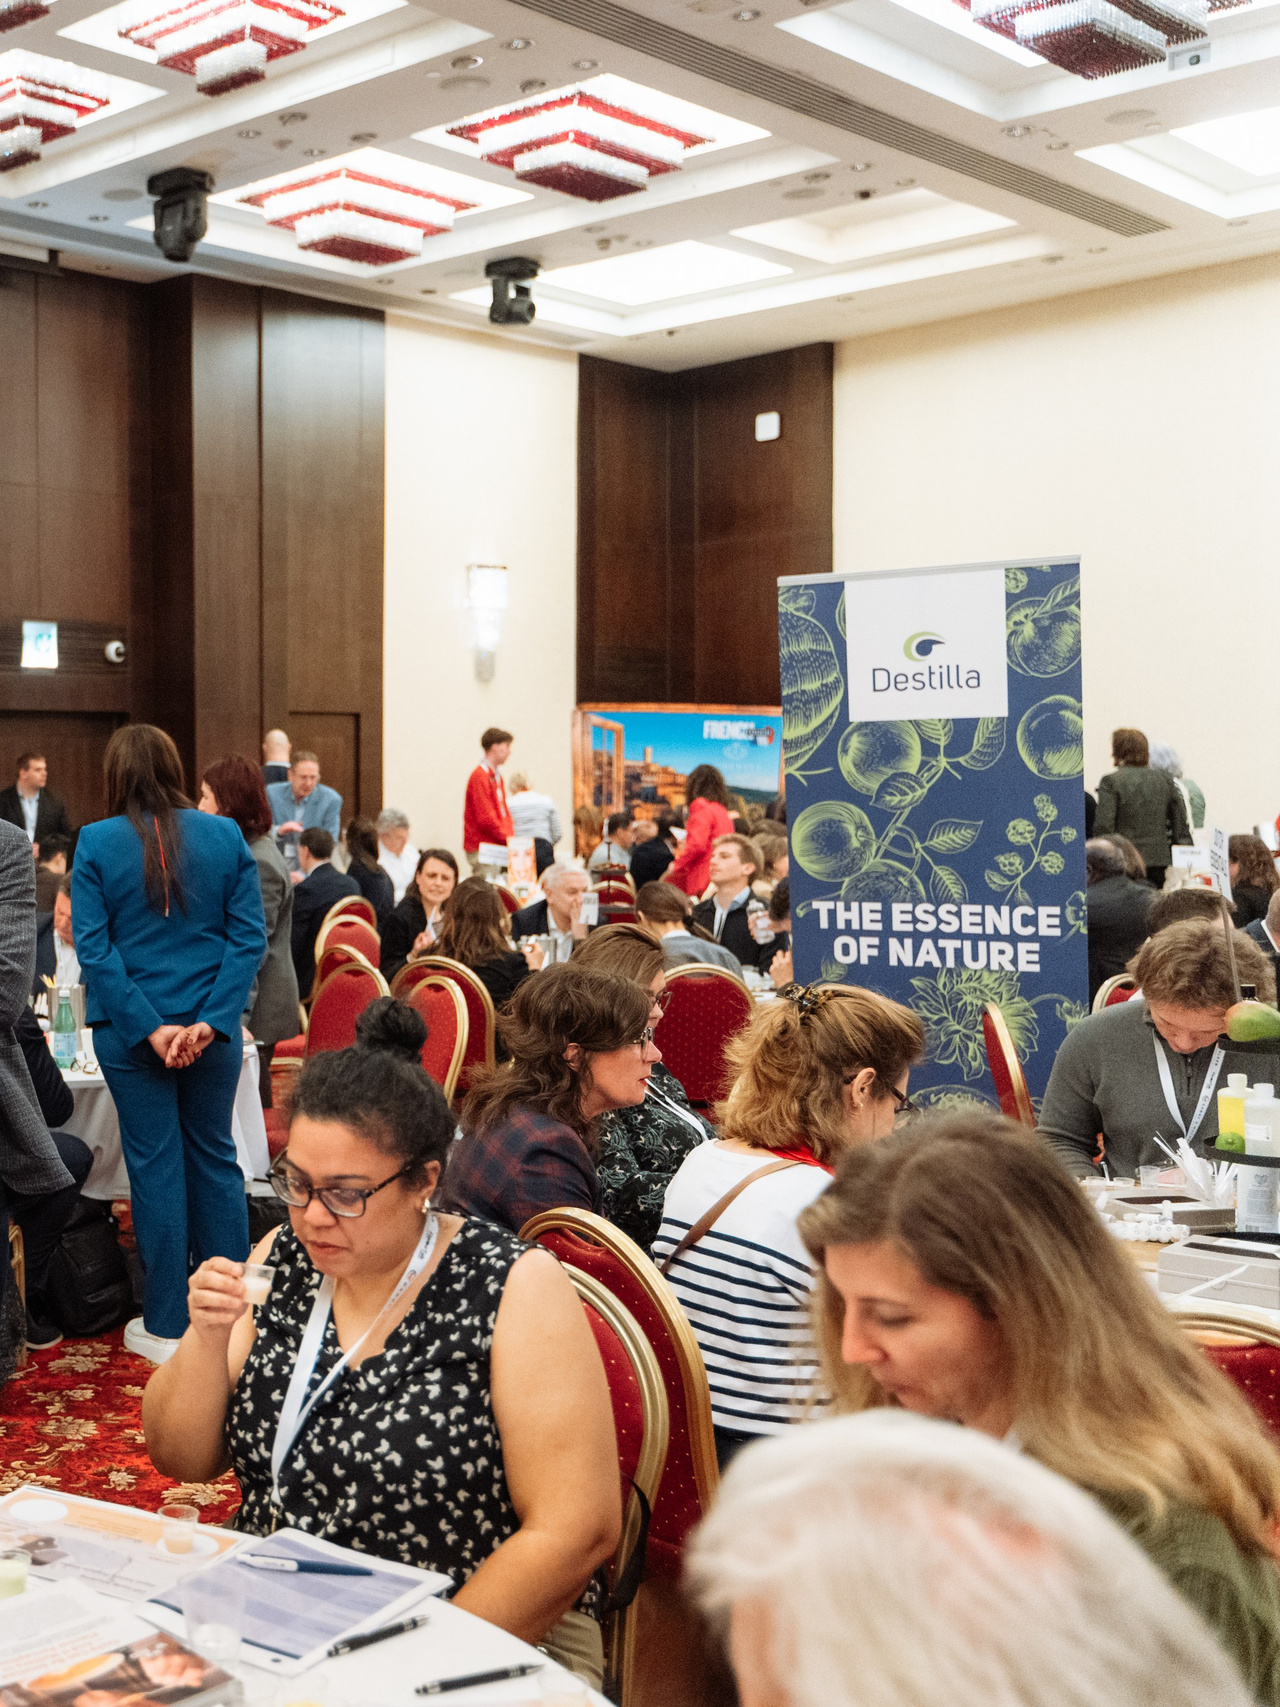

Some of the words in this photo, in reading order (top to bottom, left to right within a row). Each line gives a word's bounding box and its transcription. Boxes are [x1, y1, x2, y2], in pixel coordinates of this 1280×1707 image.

[872, 664, 981, 692] Destilla
[812, 901, 882, 931] THE
[891, 902, 1061, 937] ESSENCE
[833, 935, 879, 965] OF
[888, 939, 1041, 972] NATURE
